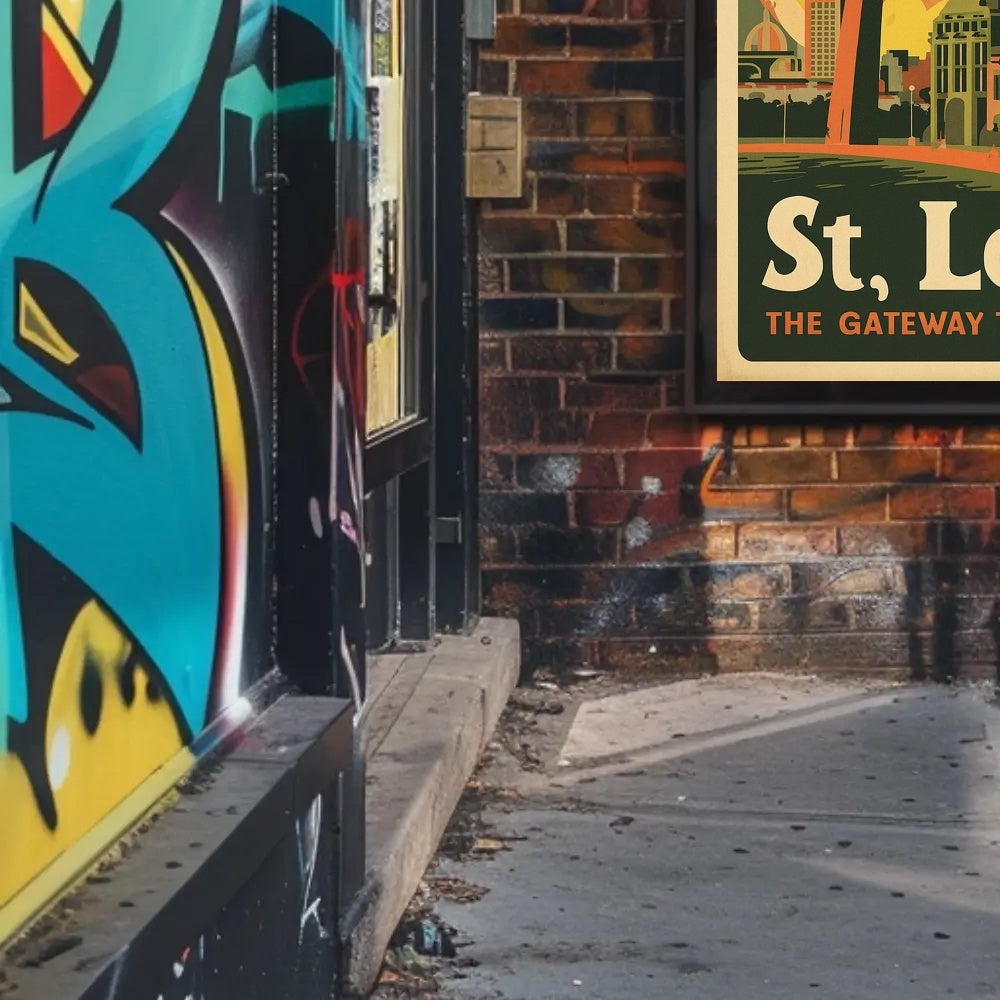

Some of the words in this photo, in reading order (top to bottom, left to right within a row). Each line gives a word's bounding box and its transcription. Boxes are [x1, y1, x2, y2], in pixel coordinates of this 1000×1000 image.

[761, 195, 890, 302] St,
[765, 311, 822, 336] THE
[838, 311, 984, 336] GATEWAY
